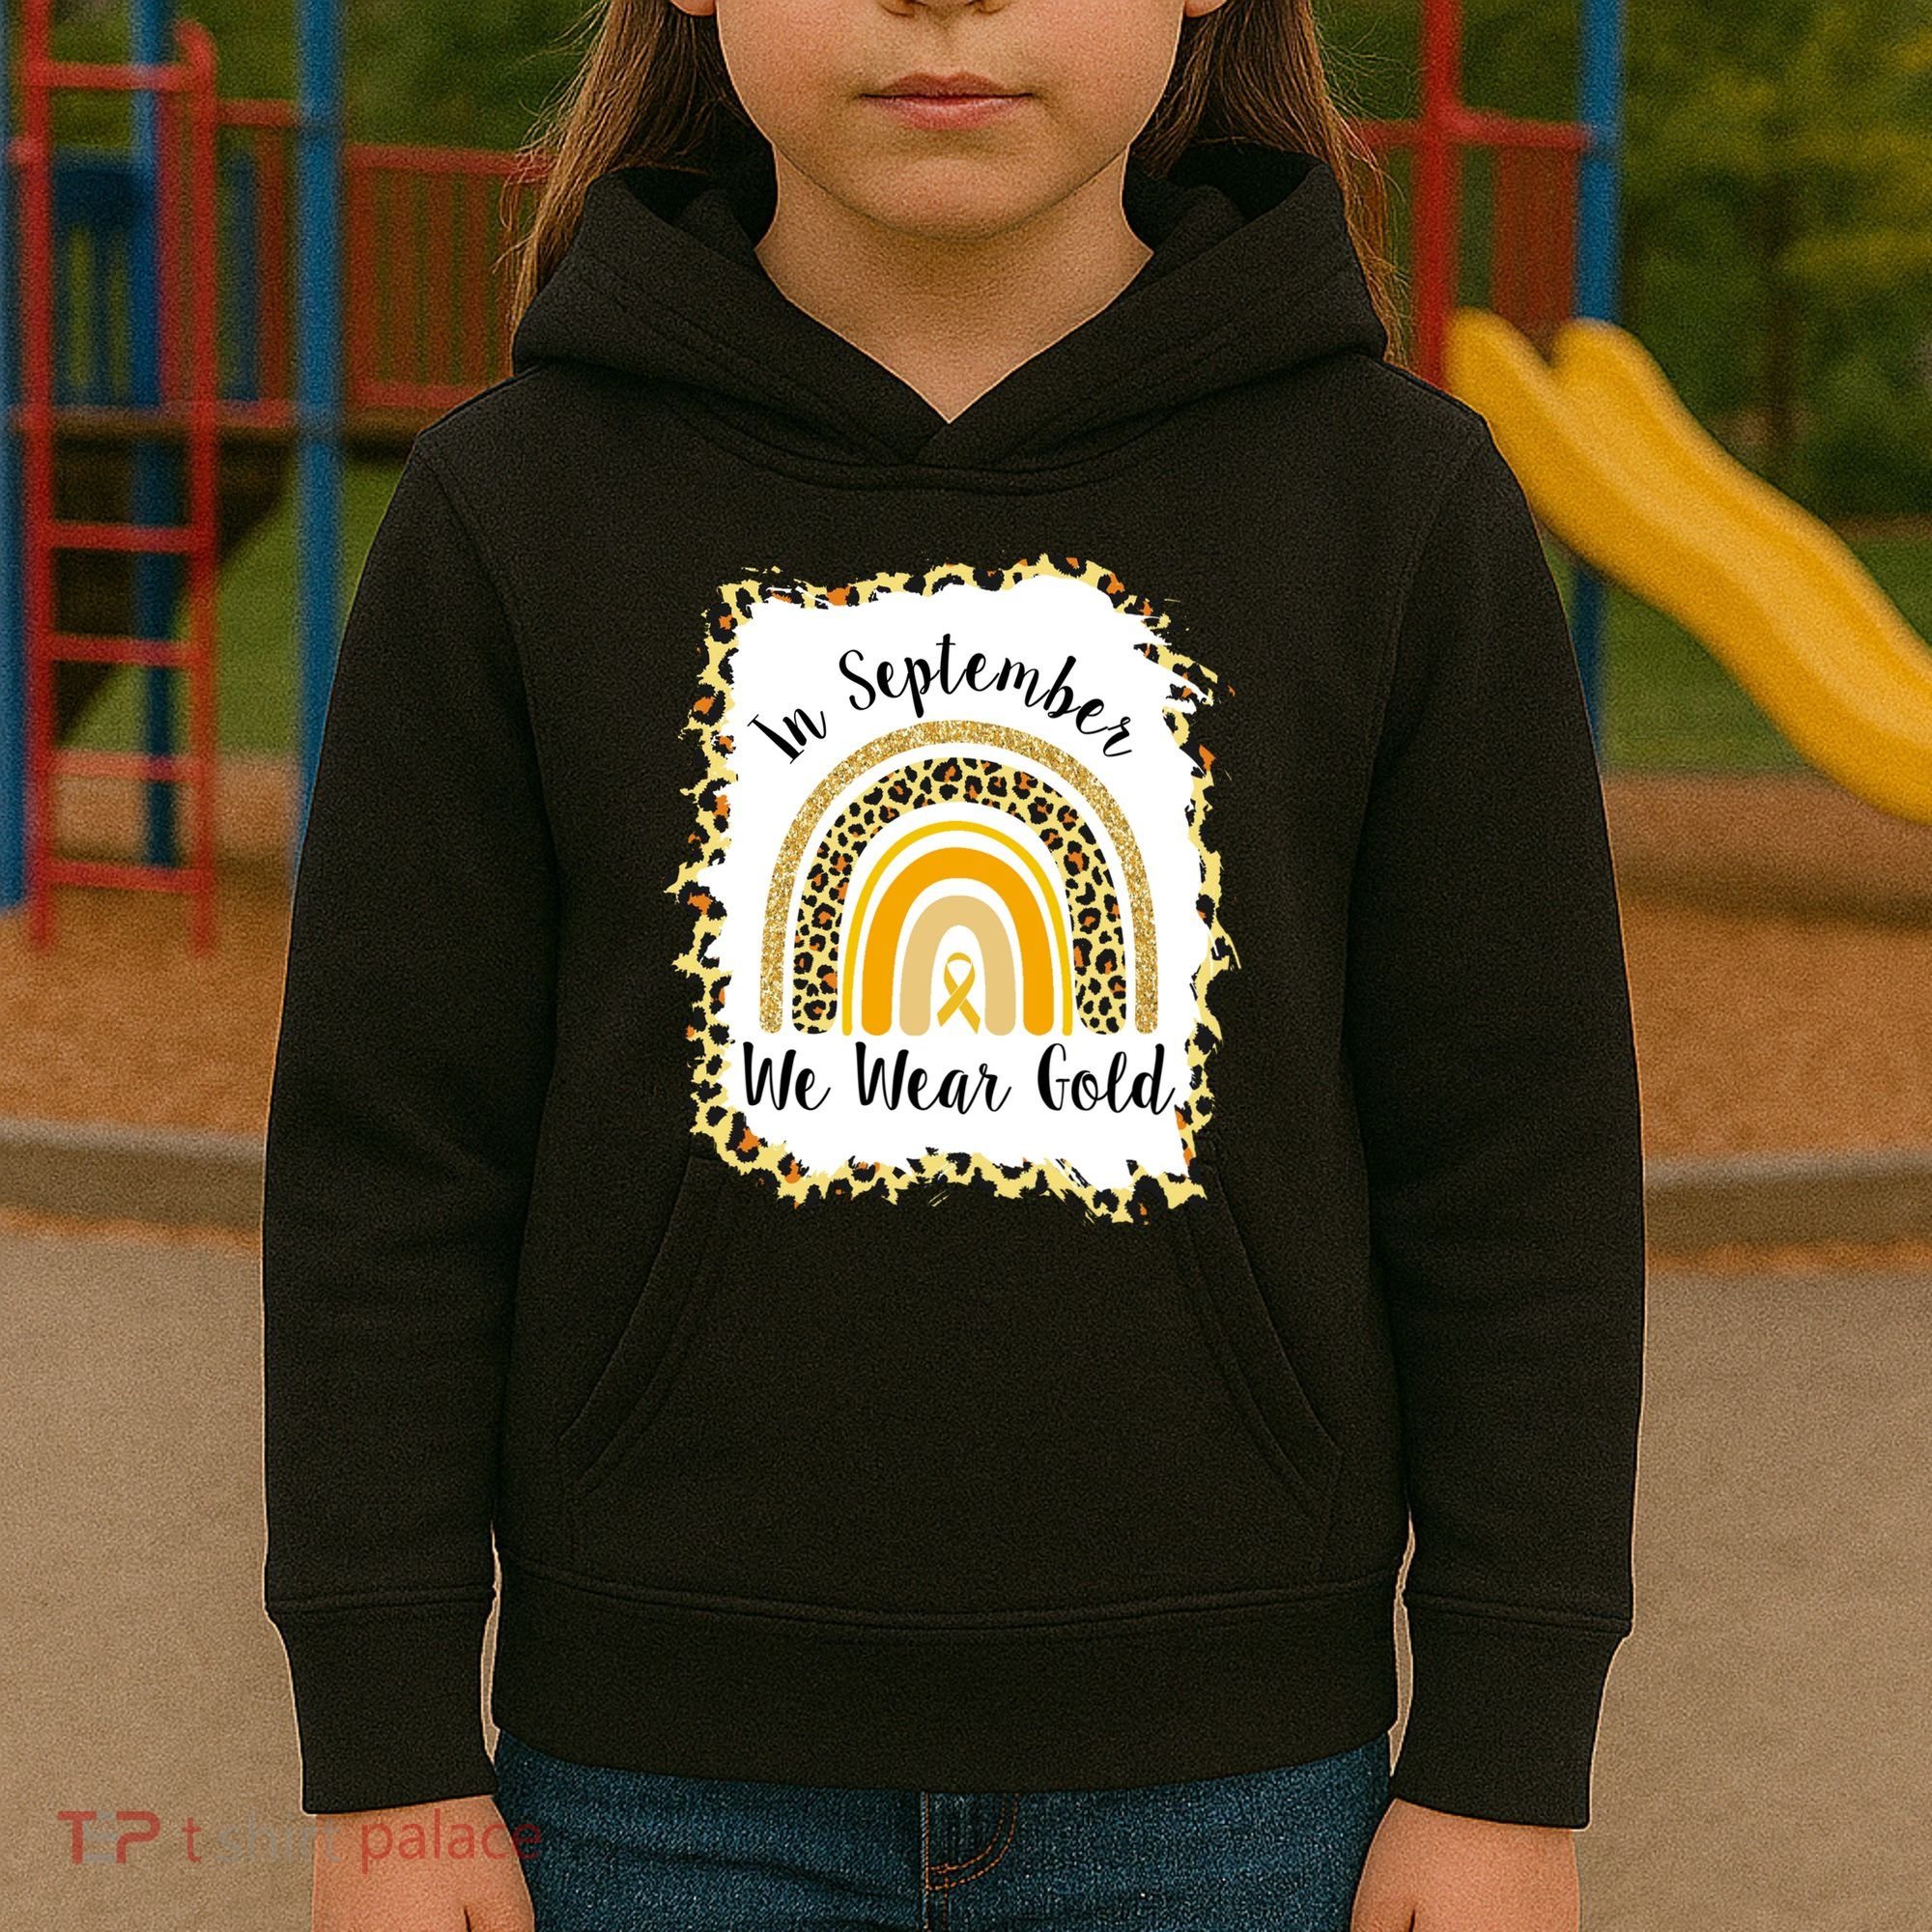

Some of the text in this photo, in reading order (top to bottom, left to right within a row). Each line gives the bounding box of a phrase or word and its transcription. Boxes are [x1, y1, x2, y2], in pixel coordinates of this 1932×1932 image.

[747, 633, 1132, 764] In September
[742, 1041, 1176, 1114] We Wear Gold
